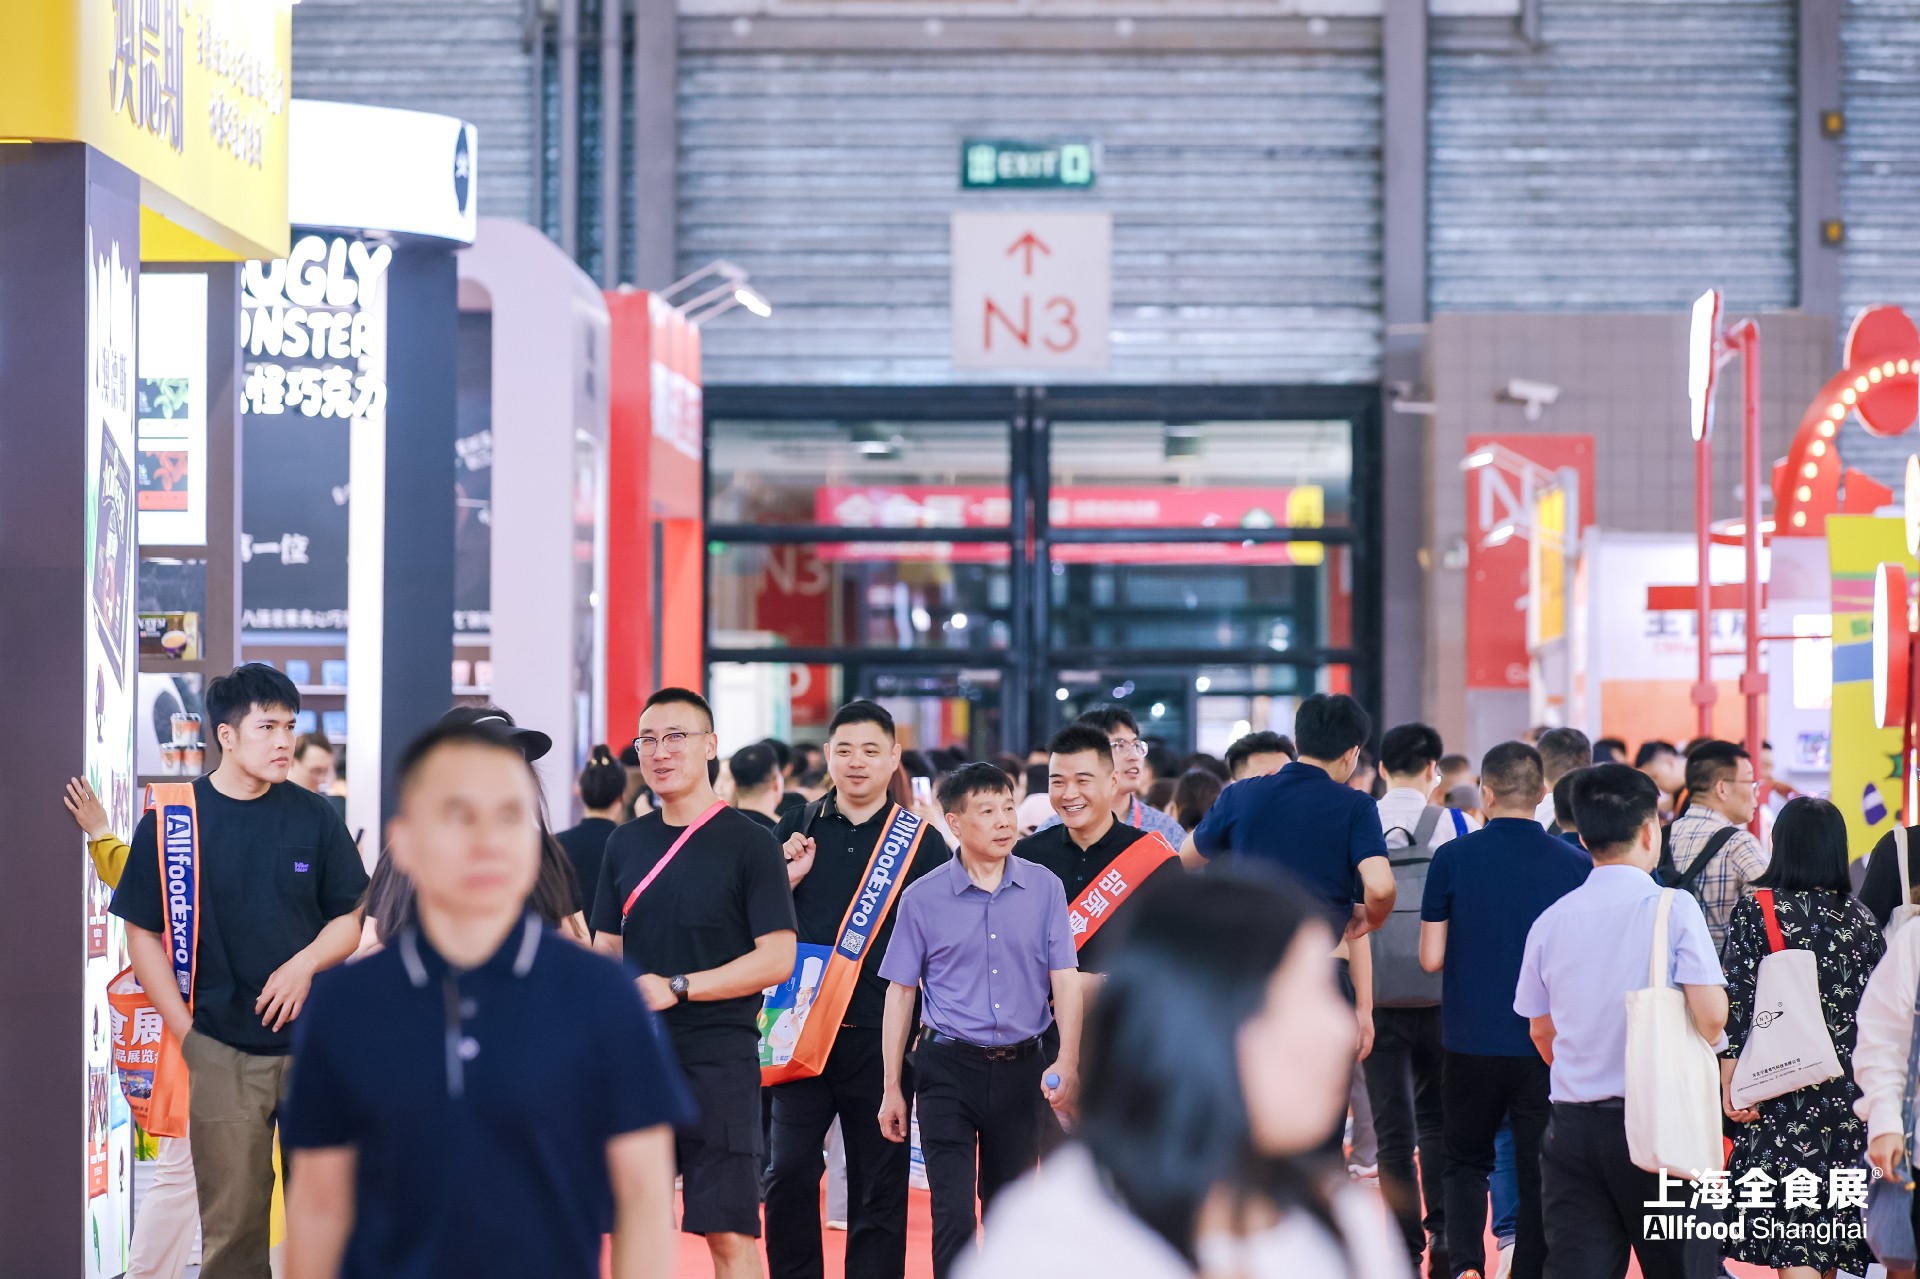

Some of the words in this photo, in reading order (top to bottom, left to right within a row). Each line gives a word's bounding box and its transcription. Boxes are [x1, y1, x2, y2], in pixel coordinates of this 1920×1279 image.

[245, 235, 392, 308] UGLY
[985, 294, 1080, 352] N3
[240, 365, 387, 420] 怪巧克力
